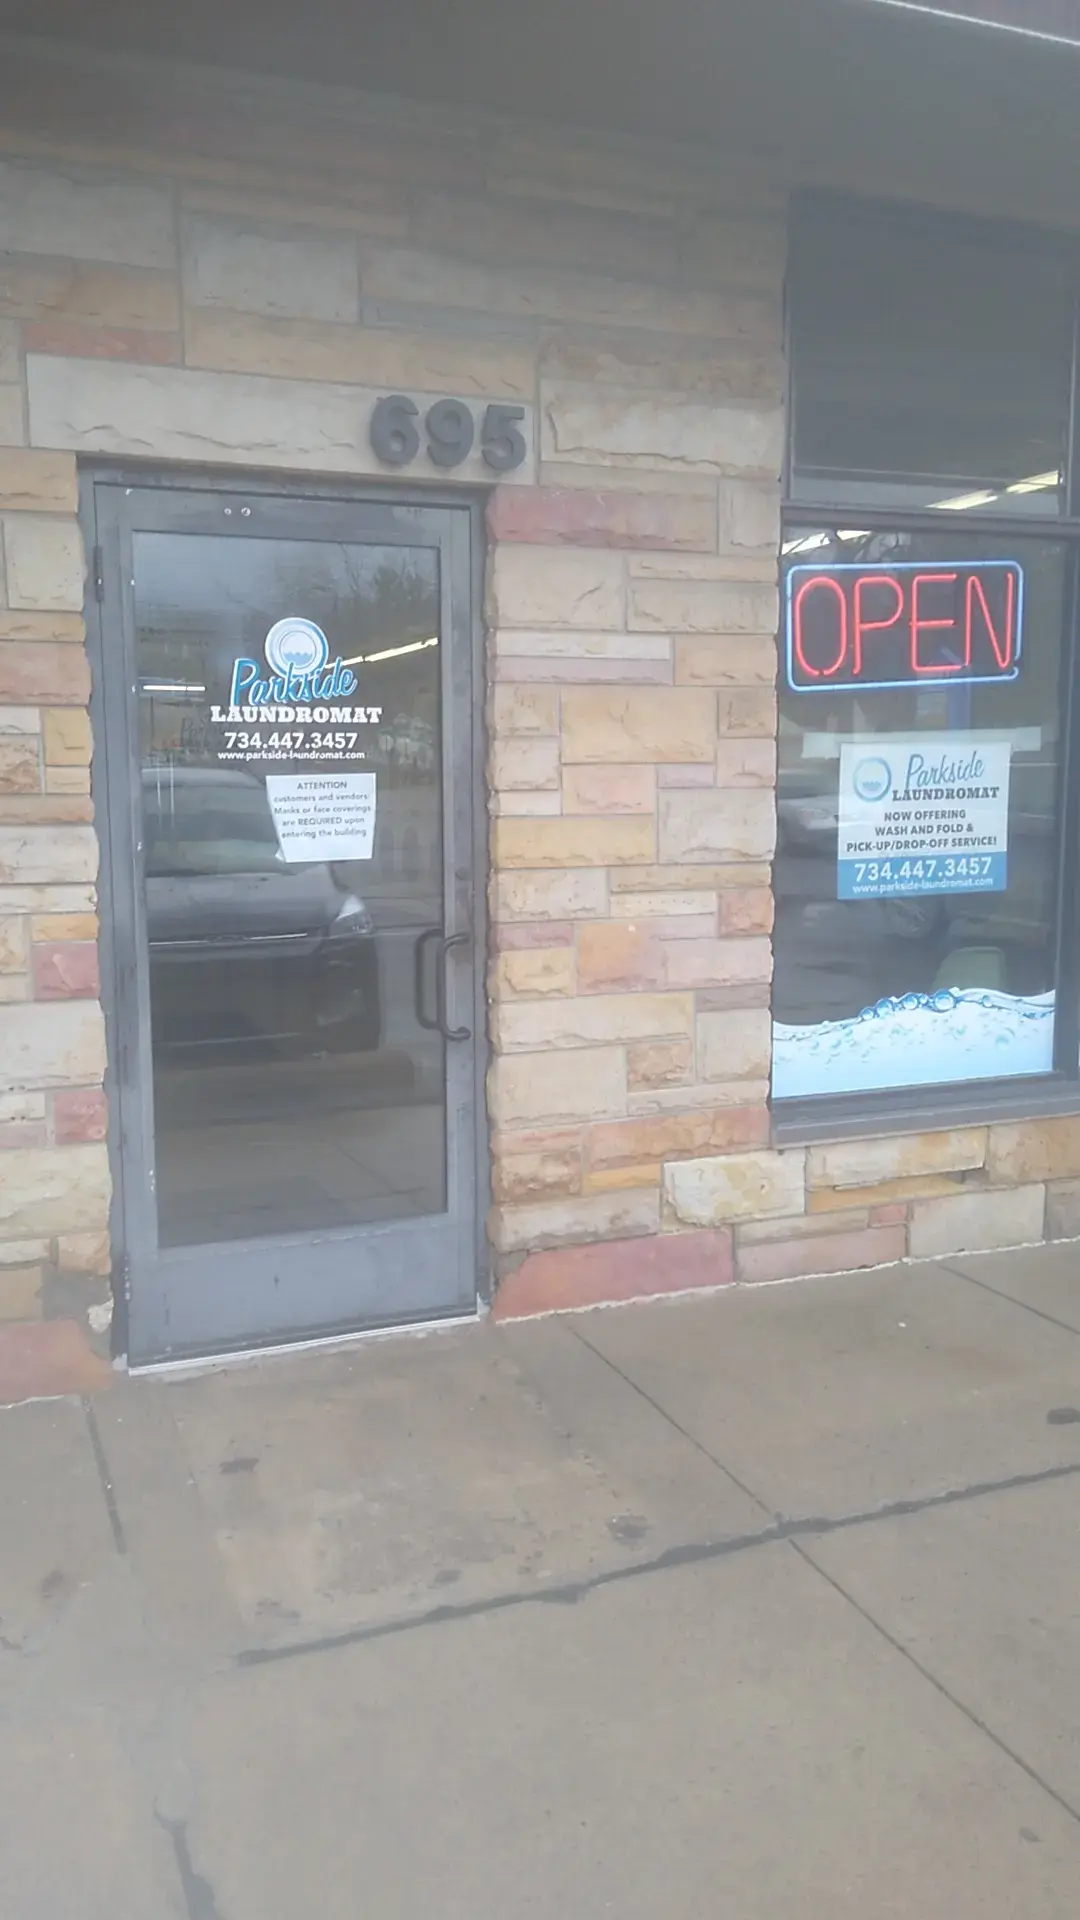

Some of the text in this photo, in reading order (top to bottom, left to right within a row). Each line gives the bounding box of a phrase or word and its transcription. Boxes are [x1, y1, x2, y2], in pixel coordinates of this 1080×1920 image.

[370, 394, 527, 472] 695
[794, 572, 1013, 677] OPEN
[231, 656, 358, 706] Parkside
[210, 706, 382, 723] LAUNDROMAT
[224, 731, 358, 749] 734.447.3457
[217, 750, 366, 761] www.parkside-laundromat.com
[905, 751, 985, 789] Parkside
[297, 781, 347, 790] ATTENTION
[318, 793, 333, 801] and
[892, 787, 999, 801] LAUNDROMAT
[332, 805, 371, 813] coverings
[884, 809, 967, 821] NOW OFFERING
[297, 817, 342, 826] REQUIRED
[281, 830, 317, 839] entering
[334, 828, 367, 837] building
[875, 823, 974, 836] WASH AND FOLD &
[846, 836, 997, 852] PICK-UP/DROP-OFF SERVICE!
[854, 857, 992, 882] 734.447.3457
[853, 877, 994, 893] www.parkside-laundromat.com
